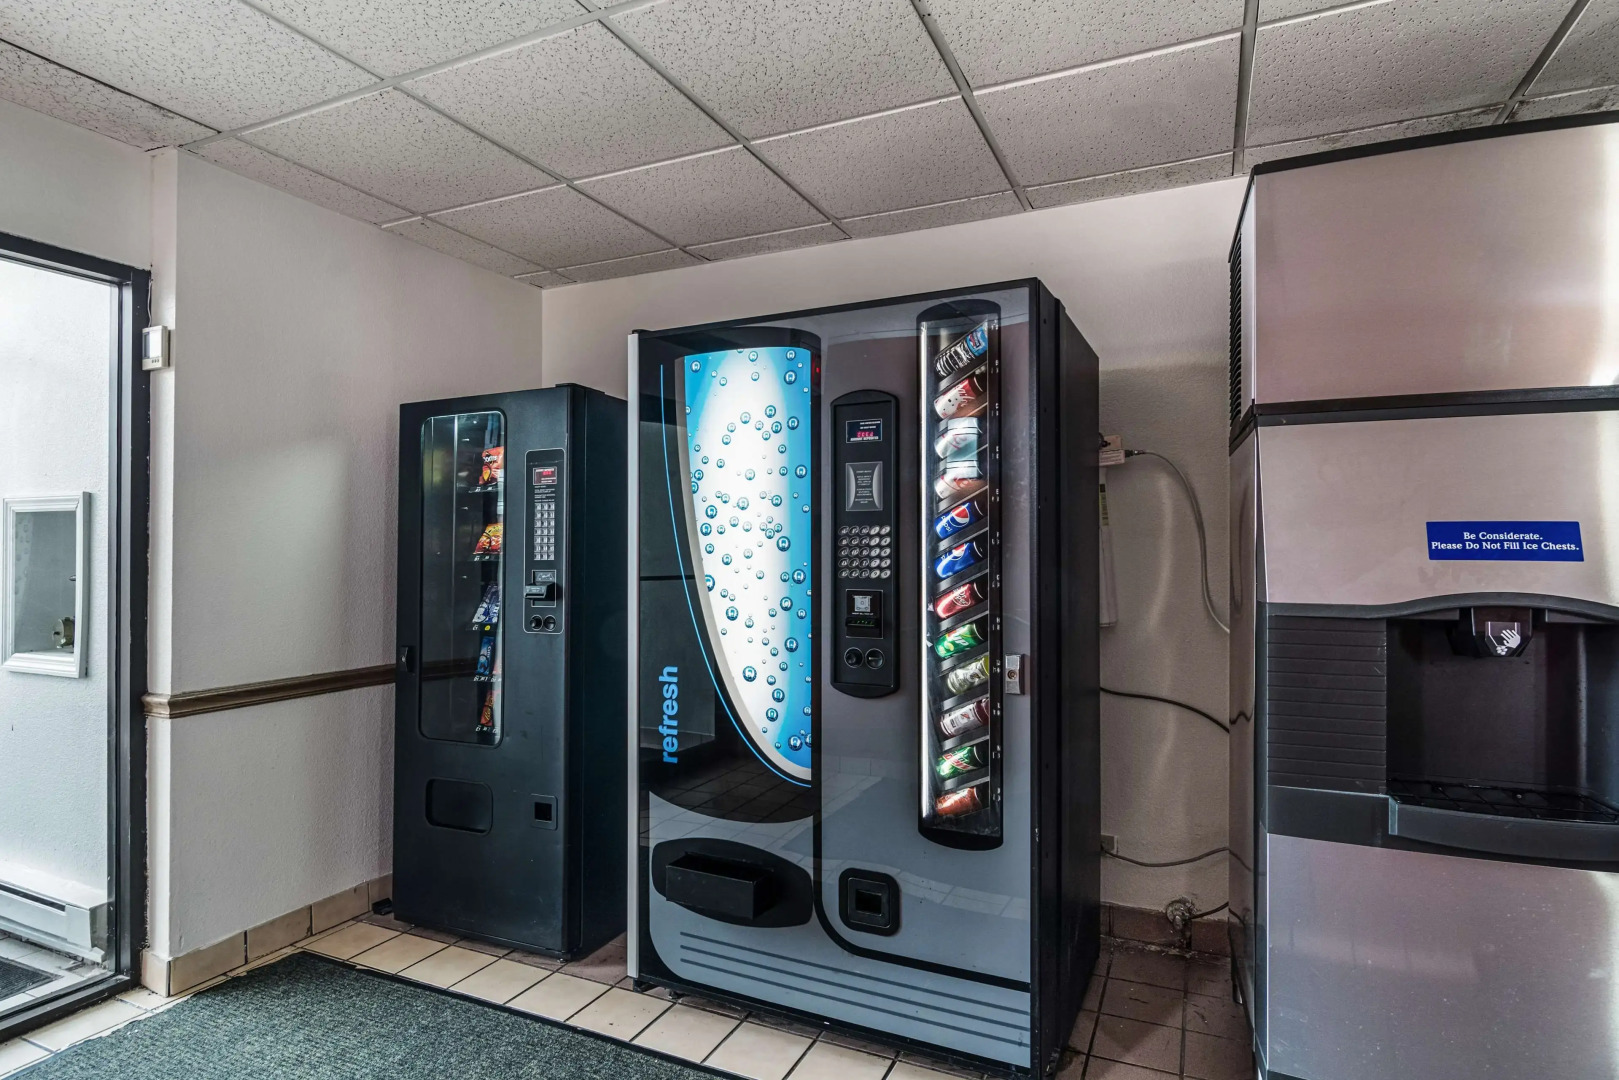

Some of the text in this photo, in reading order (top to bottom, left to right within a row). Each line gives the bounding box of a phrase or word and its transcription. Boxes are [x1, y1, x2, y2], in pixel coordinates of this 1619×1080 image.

[1463, 532, 1543, 540] Be Considerate.
[1431, 542, 1580, 551] Please Do Not Fill Ice Chests.
[658, 665, 679, 764] refresh
